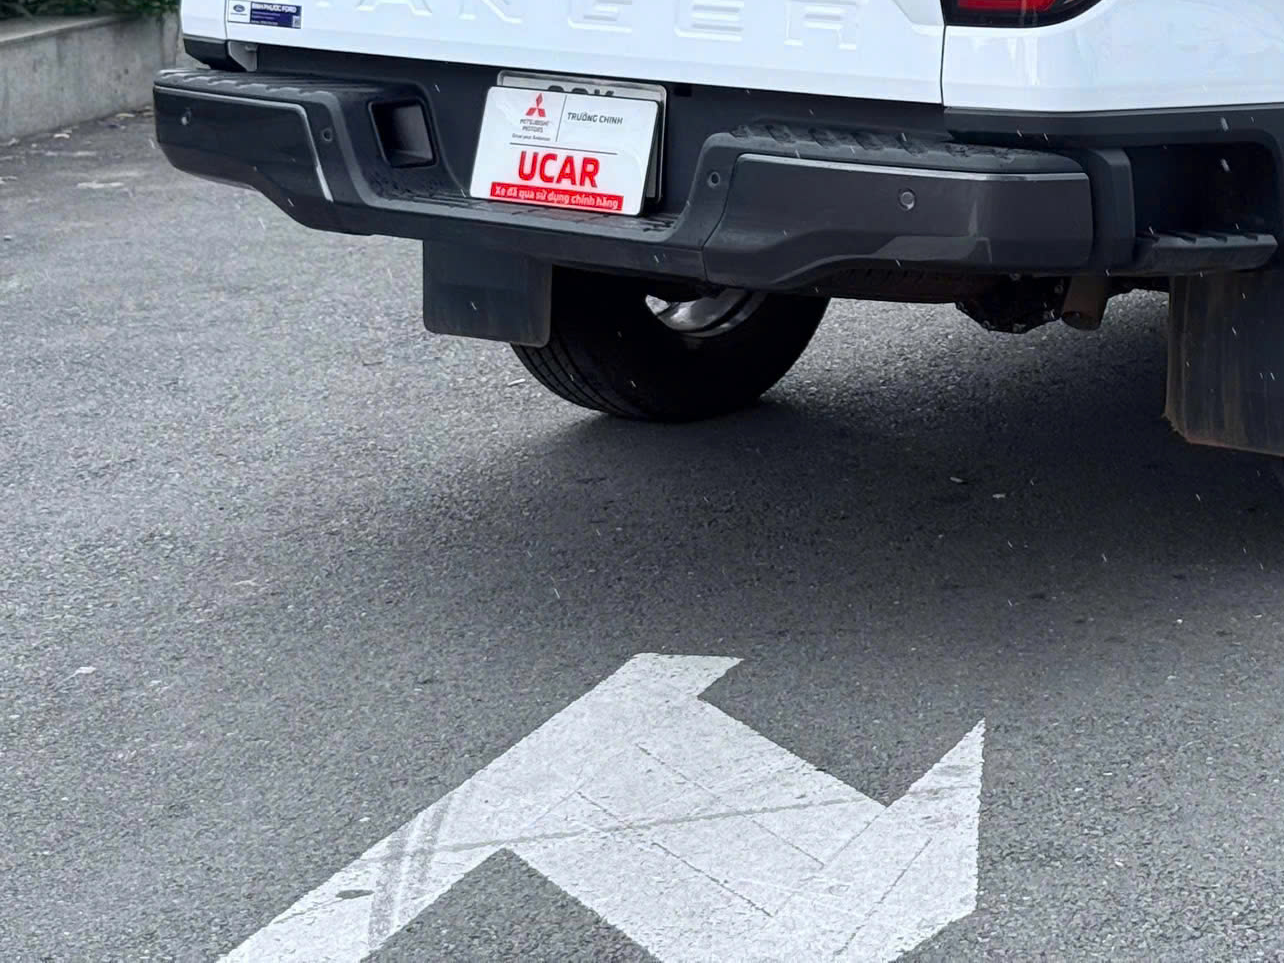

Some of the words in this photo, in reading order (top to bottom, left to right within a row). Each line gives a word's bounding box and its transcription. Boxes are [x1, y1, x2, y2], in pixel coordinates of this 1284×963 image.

[518, 151, 600, 188] UCAR
[495, 185, 506, 197] Xe
[507, 187, 518, 197] đã
[519, 190, 535, 201] qua
[548, 191, 570, 205] dụng
[571, 193, 595, 206] chính
